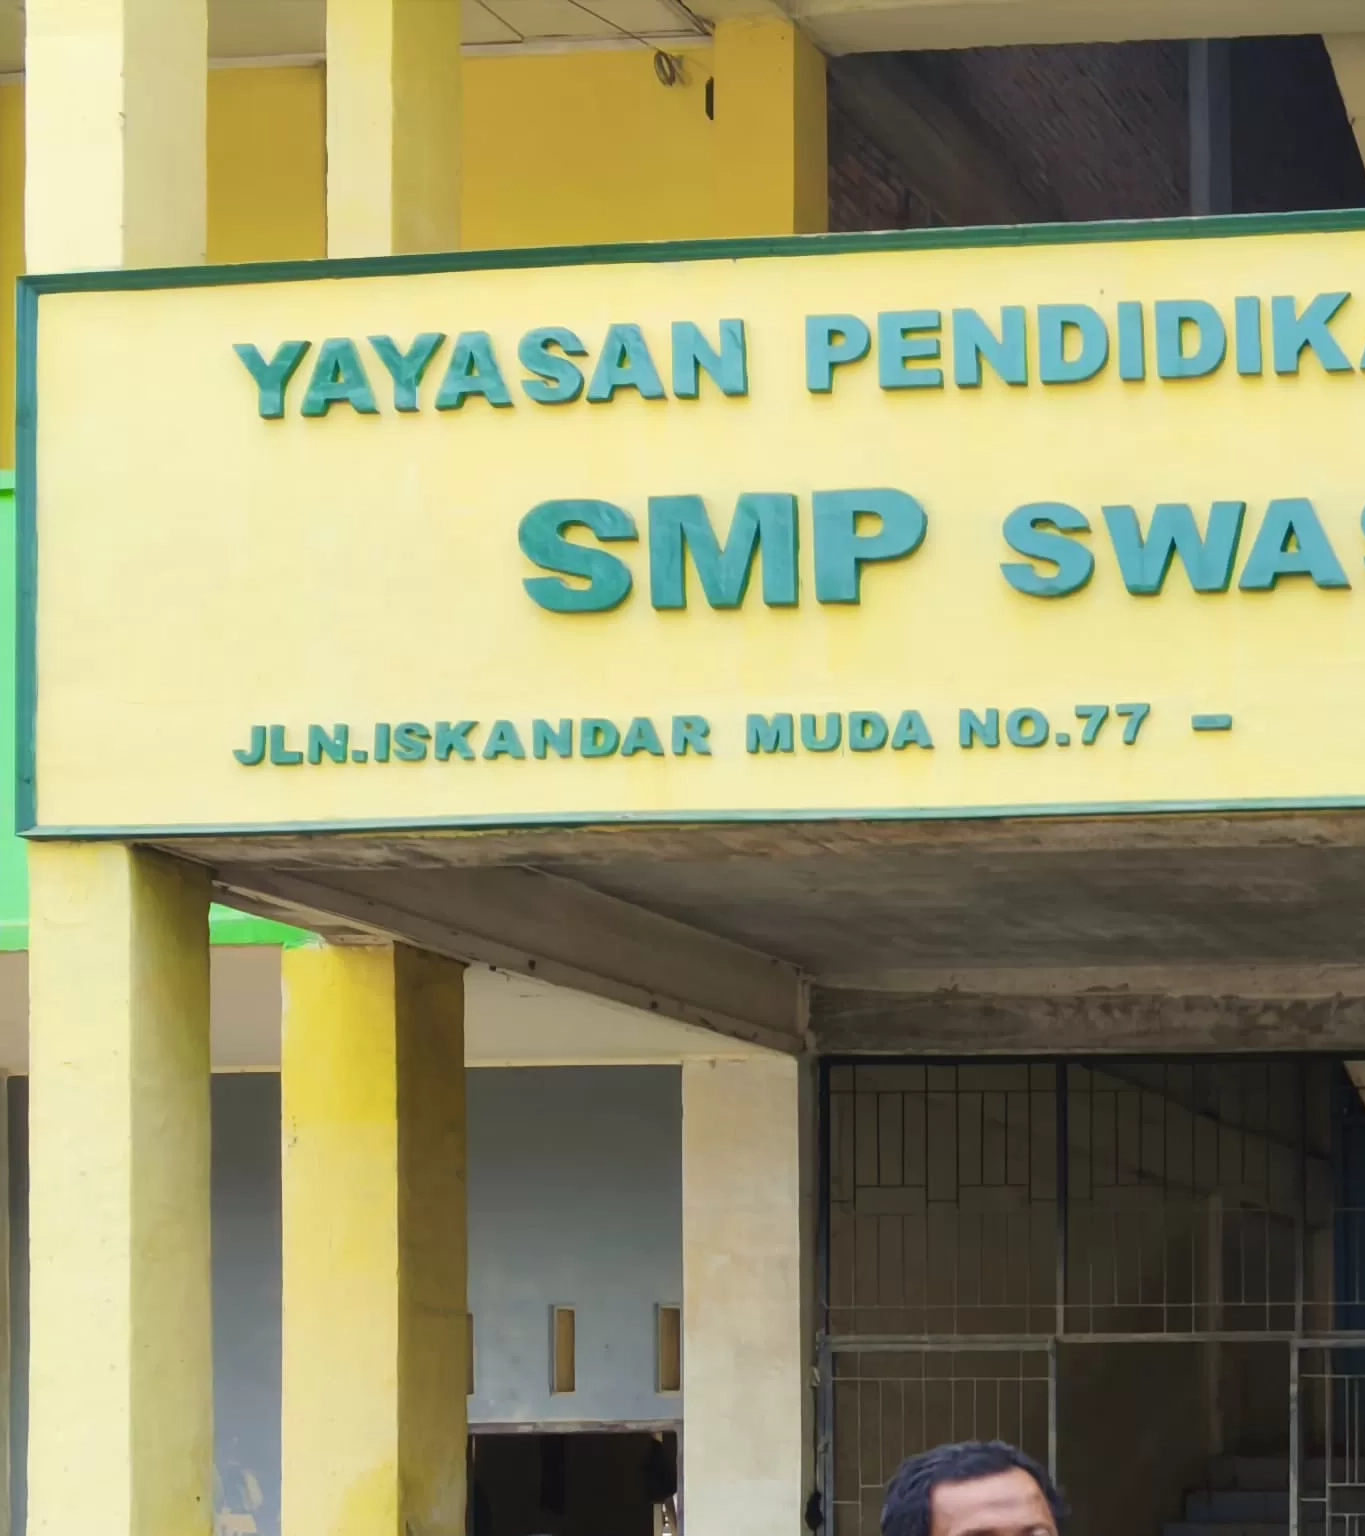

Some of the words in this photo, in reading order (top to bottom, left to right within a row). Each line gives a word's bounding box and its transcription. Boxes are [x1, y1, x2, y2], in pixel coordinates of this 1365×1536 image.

[234, 318, 748, 420] YAYASAN
[517, 488, 929, 615] SMP
[233, 714, 713, 767] JLN.ISKANDAR
[746, 710, 935, 755] MUDA
[959, 703, 1151, 750] NO.77
